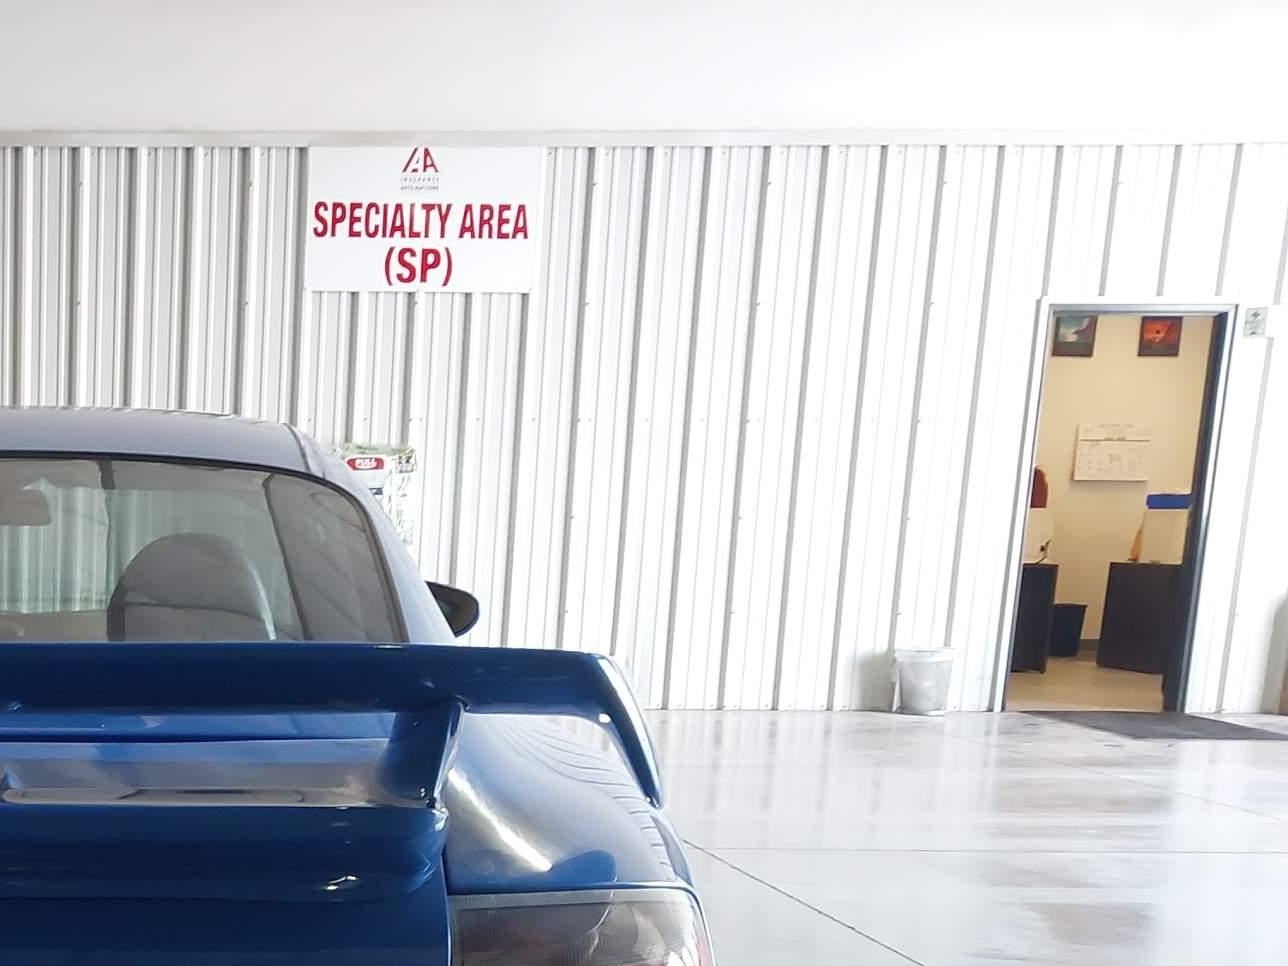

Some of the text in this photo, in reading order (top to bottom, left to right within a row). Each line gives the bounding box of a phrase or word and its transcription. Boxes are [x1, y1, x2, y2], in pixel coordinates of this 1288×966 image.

[313, 201, 529, 240] SPECIALTY AREA
[384, 246, 453, 287] (SP)
